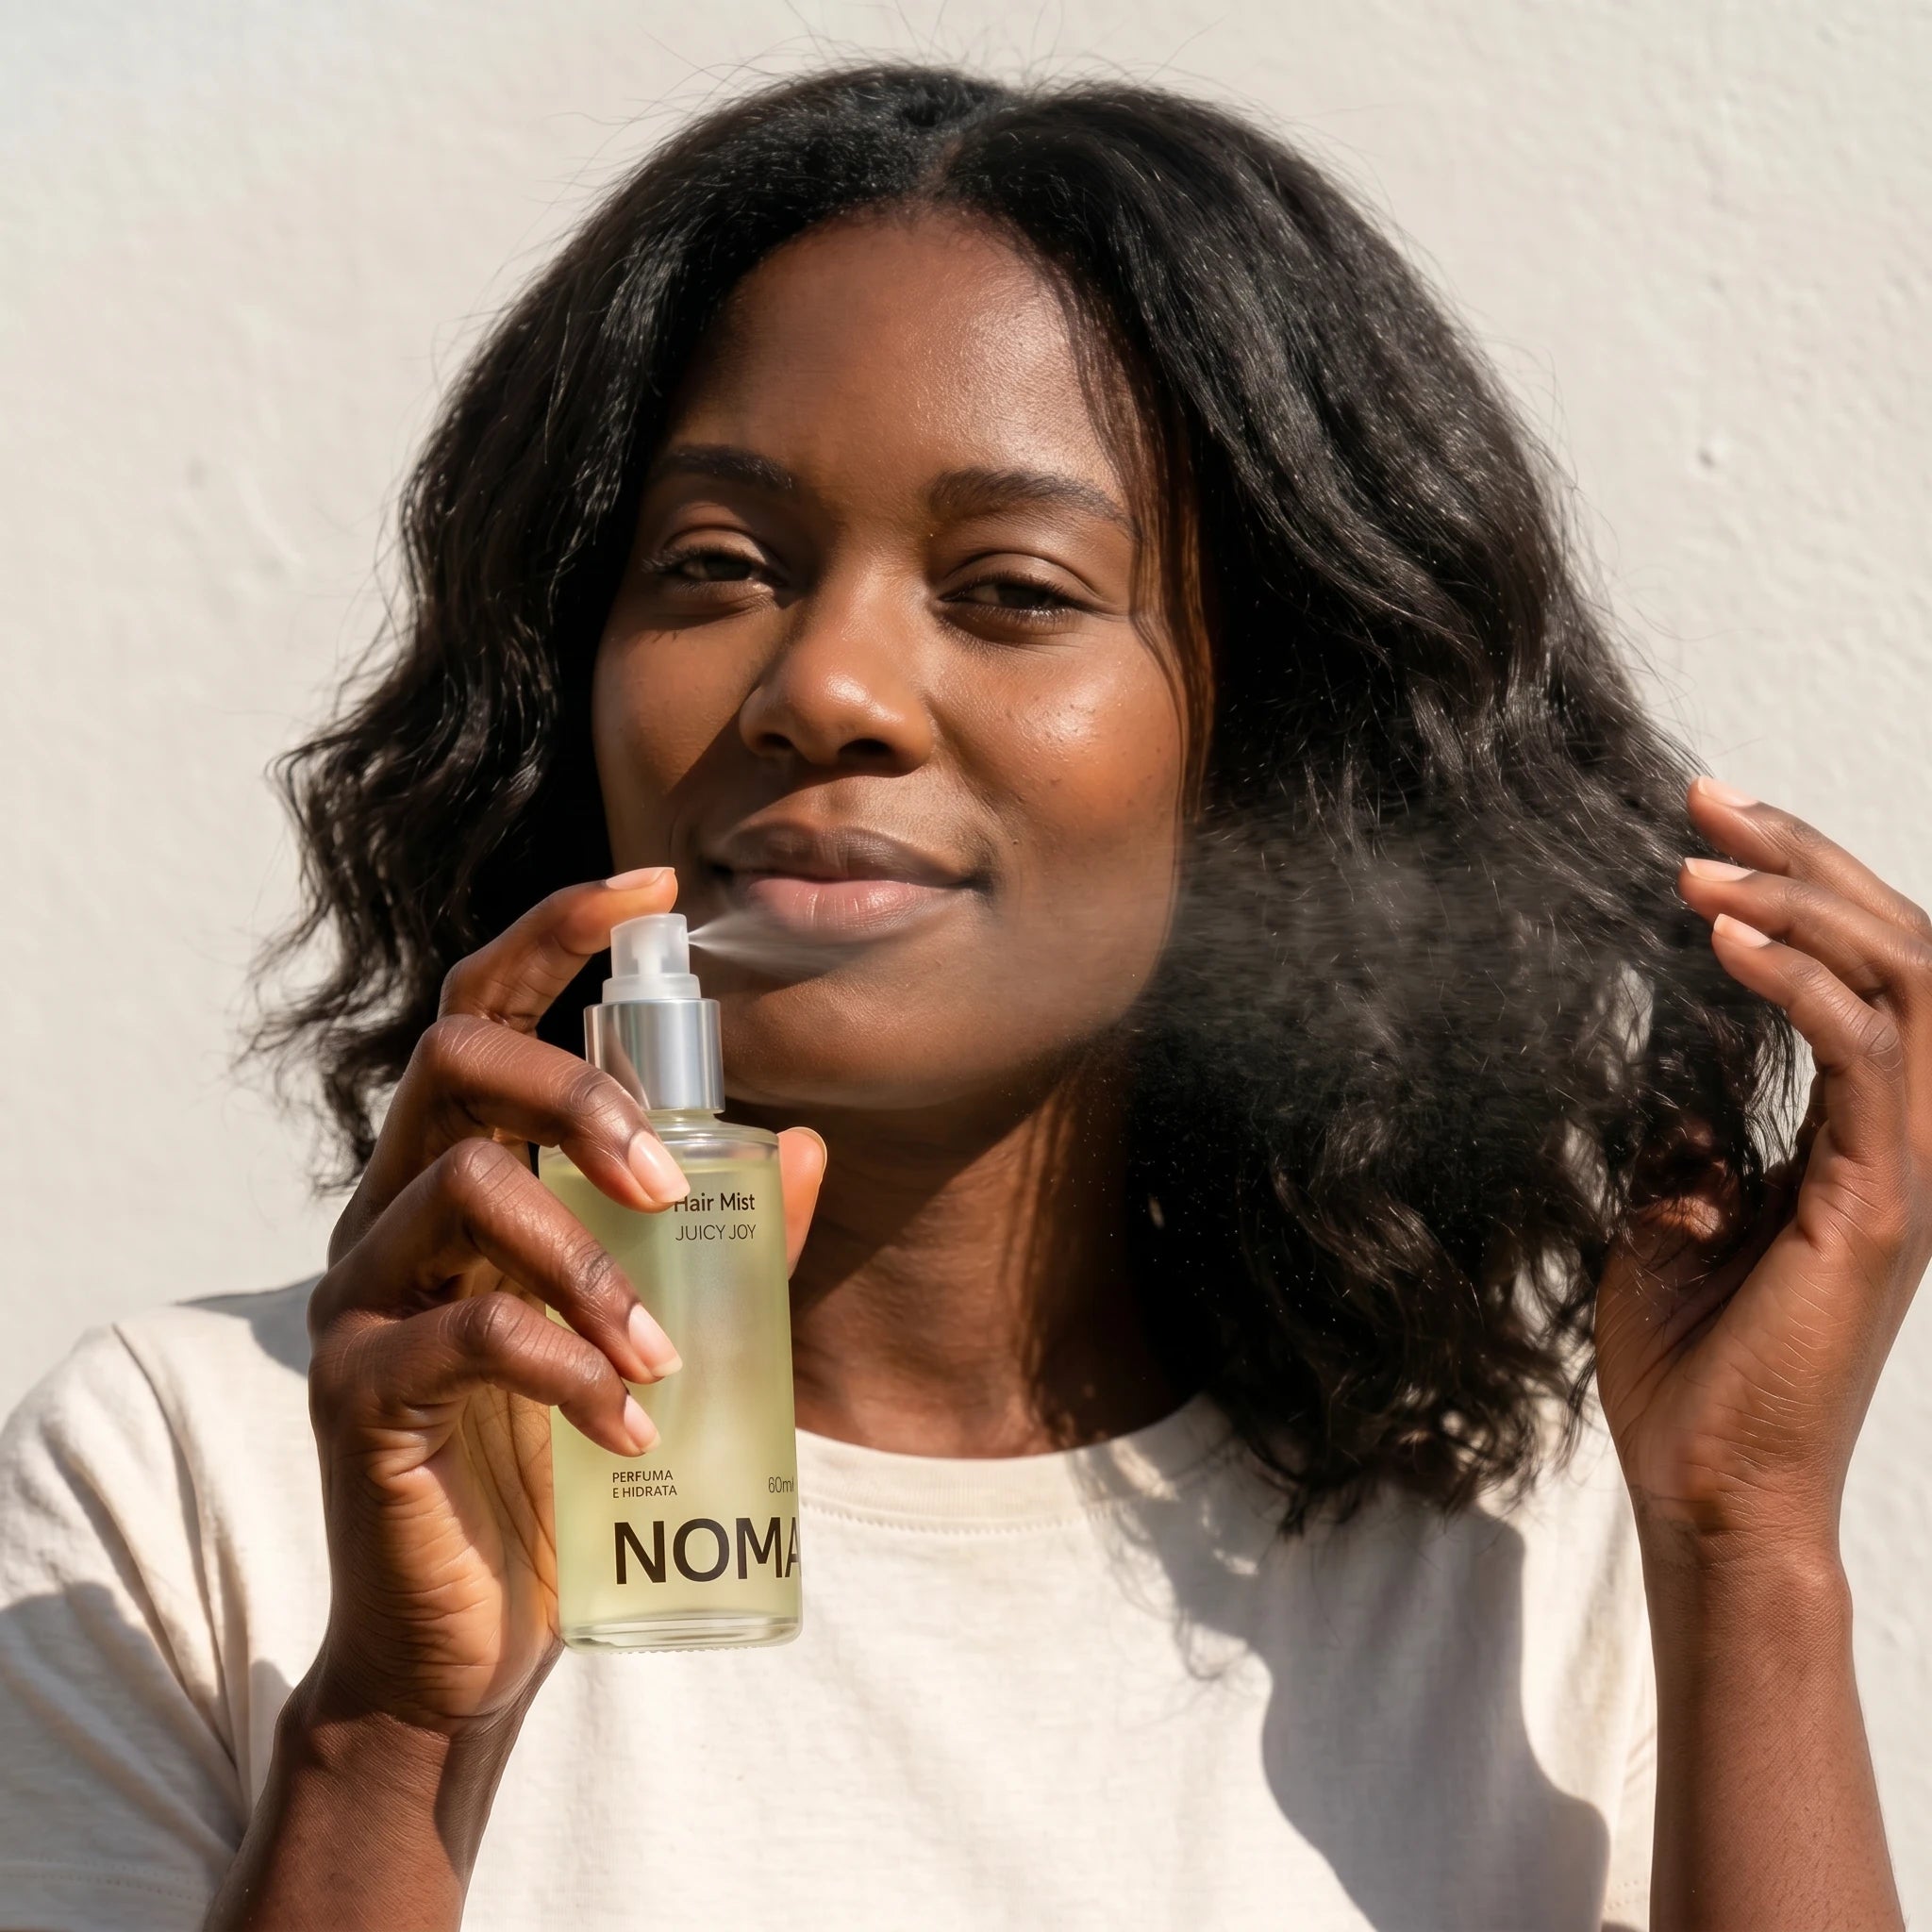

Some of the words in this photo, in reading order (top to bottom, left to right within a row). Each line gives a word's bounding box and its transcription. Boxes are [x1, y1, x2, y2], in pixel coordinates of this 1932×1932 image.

[675, 1192, 714, 1212] Hair
[720, 1192, 756, 1211] Mist
[675, 1224, 725, 1241] JUICY
[728, 1224, 757, 1240] JOY
[612, 1470, 674, 1483] PERFUMA
[768, 1475, 794, 1492] 60ml
[612, 1488, 620, 1498] E
[623, 1485, 677, 1498] HIDRATA
[614, 1517, 802, 1585] NOMA
